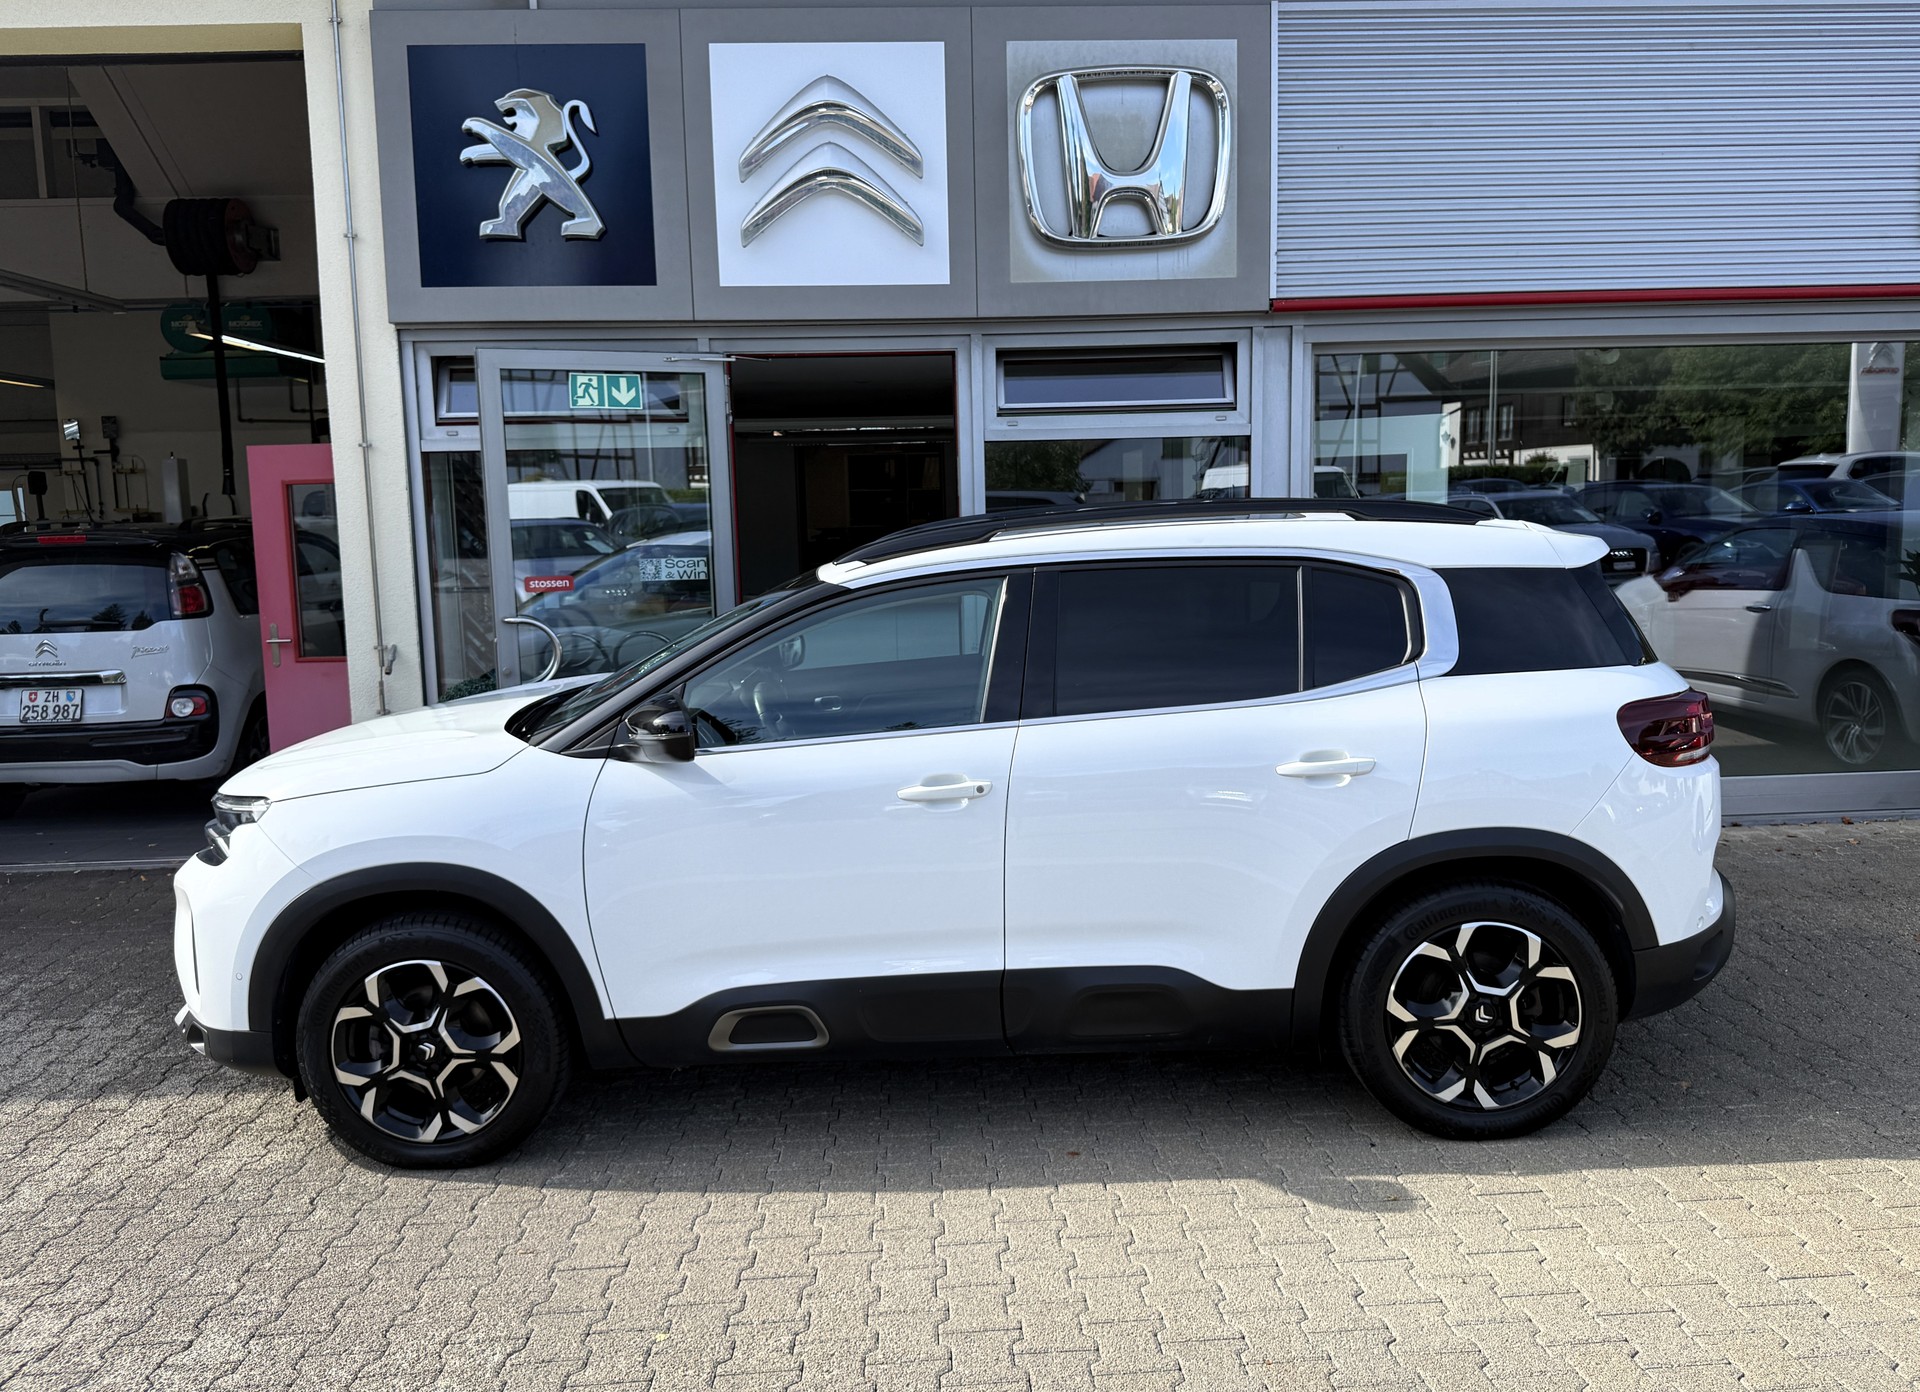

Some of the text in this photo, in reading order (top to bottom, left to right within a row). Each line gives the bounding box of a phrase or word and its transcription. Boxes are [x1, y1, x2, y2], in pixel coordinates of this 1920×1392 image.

[664, 558, 707, 569] Scan
[665, 568, 708, 579] & Win
[528, 579, 570, 589] stossen
[44, 691, 59, 703] ZH
[22, 703, 80, 720] 258 987
[1403, 900, 1485, 942] Continental
